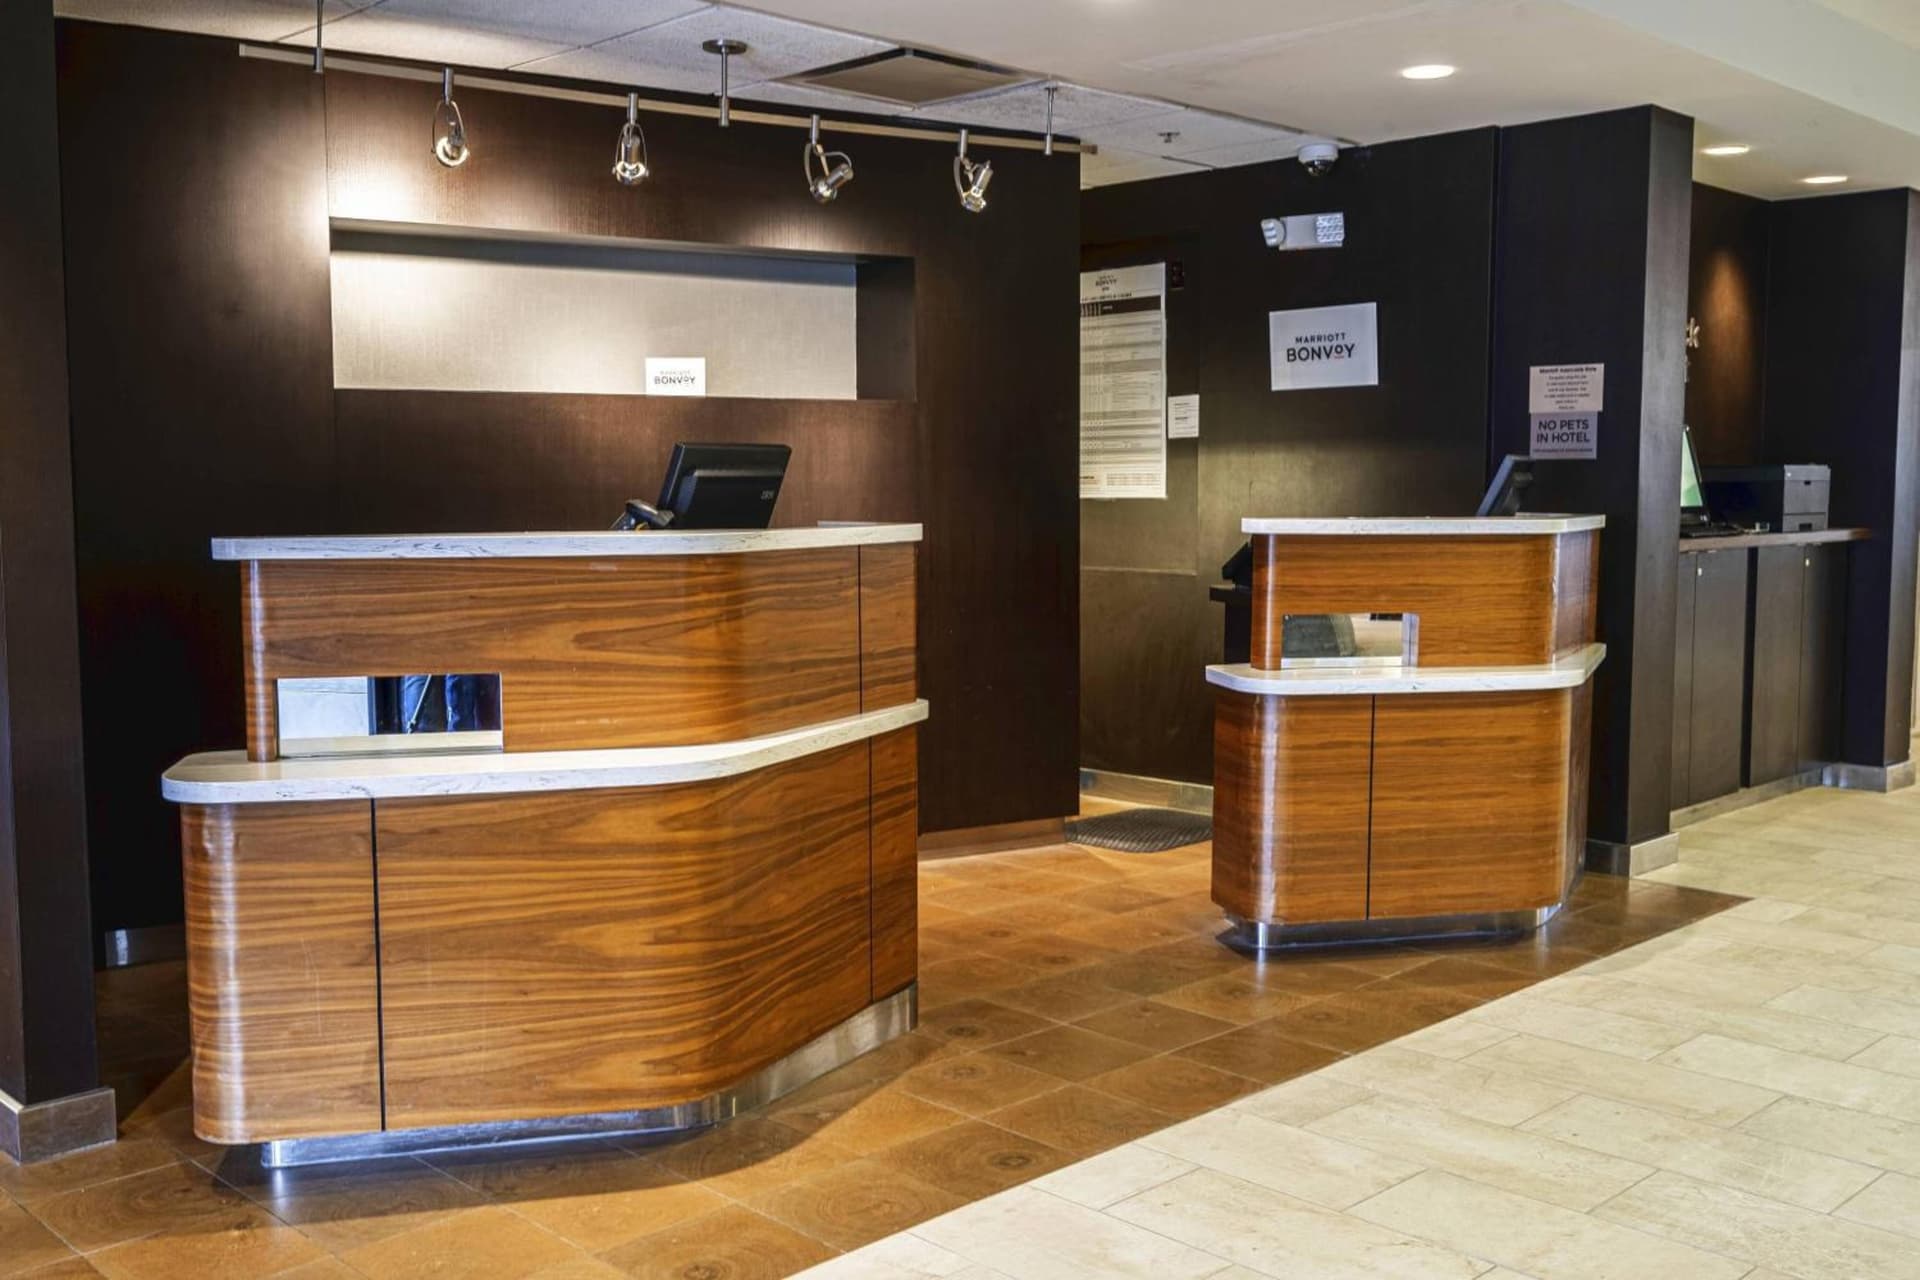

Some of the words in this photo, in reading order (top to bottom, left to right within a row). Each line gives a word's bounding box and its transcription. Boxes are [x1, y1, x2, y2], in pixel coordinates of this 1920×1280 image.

[1295, 332, 1347, 344] MARRIOTT
[1286, 343, 1355, 362] BONVOY
[654, 376, 696, 385] BONVOY
[1538, 420, 1557, 431] NO
[1560, 419, 1589, 430] PETS
[1536, 433, 1548, 443] IN
[1552, 431, 1590, 443] HOTEL
